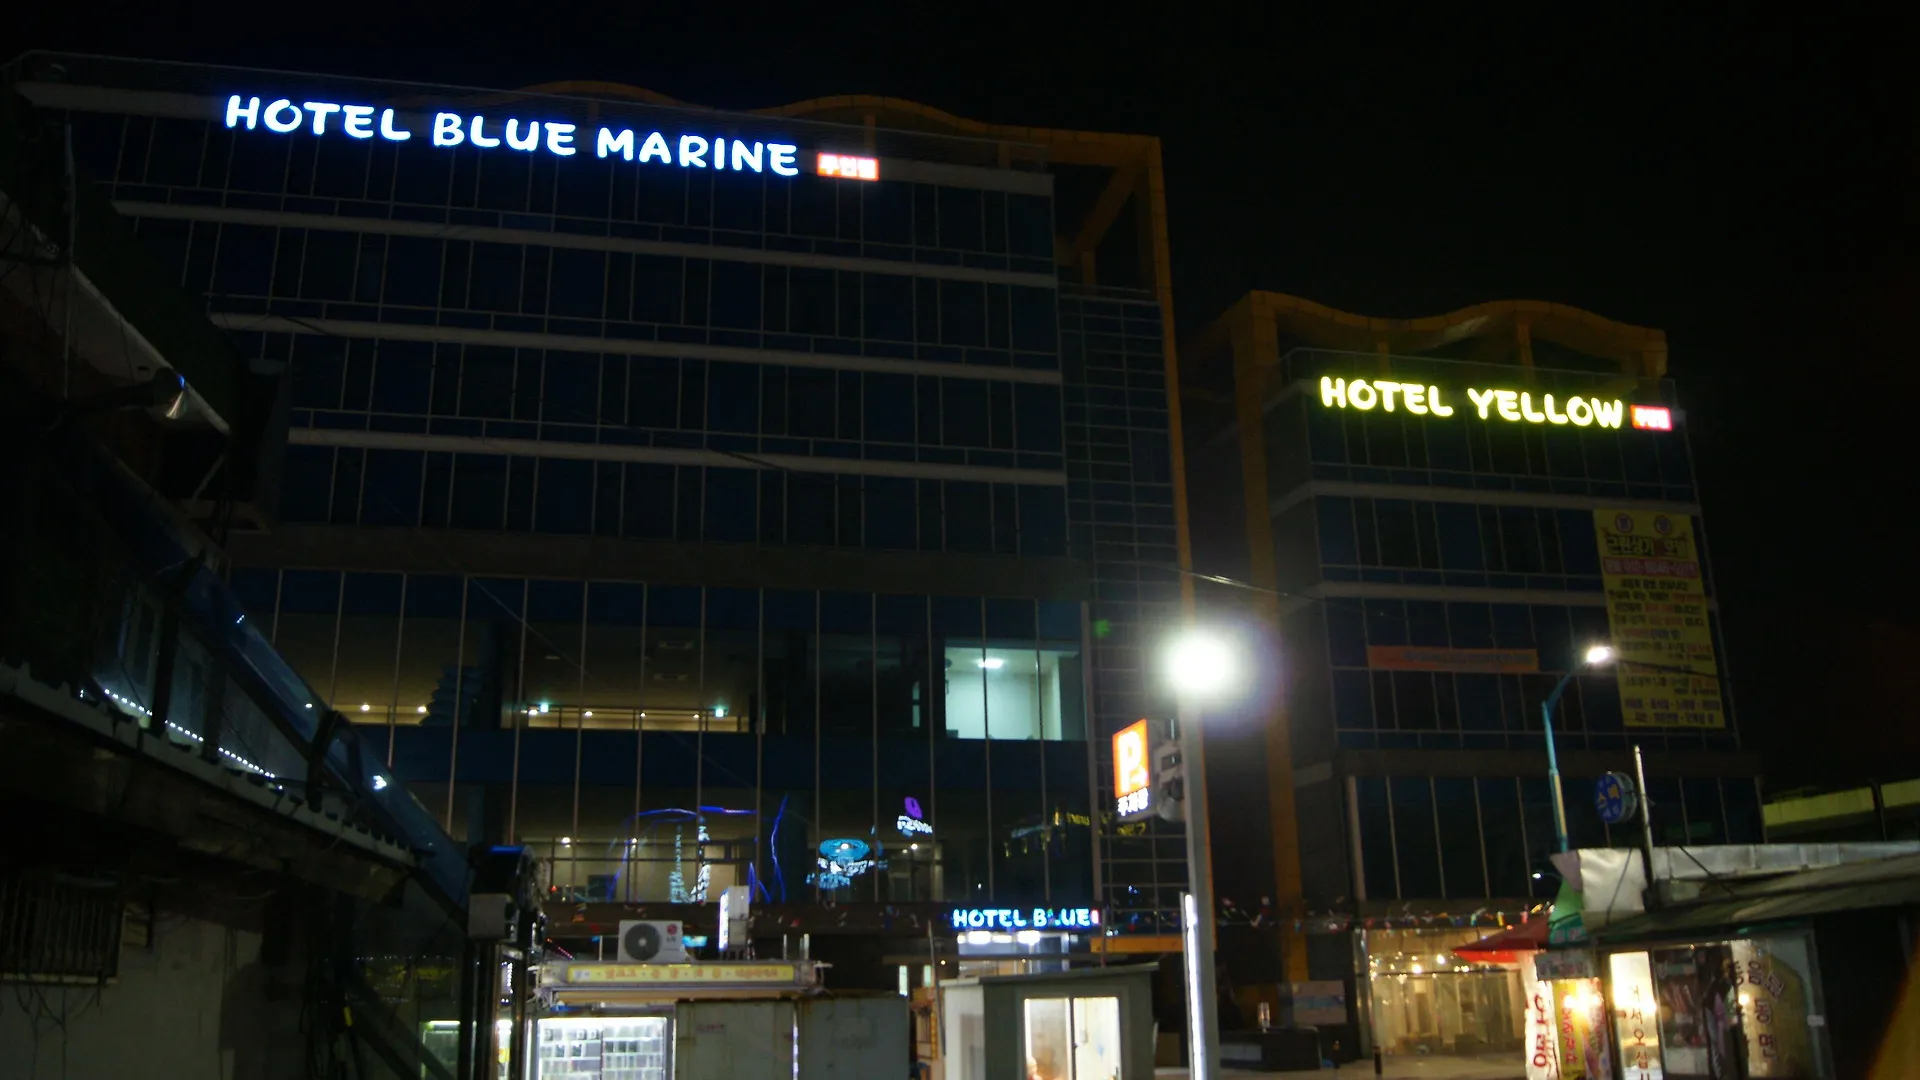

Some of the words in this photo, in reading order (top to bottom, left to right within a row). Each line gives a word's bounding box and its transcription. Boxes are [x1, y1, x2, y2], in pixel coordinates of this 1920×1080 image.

[225, 94, 411, 141] HOTEL
[433, 112, 576, 156] BLUE
[597, 127, 799, 176] MARINE
[1320, 376, 1454, 417] HOTEL
[1467, 387, 1623, 429] YELLOW
[1117, 730, 1142, 794] P
[953, 909, 1027, 928] HOTEL
